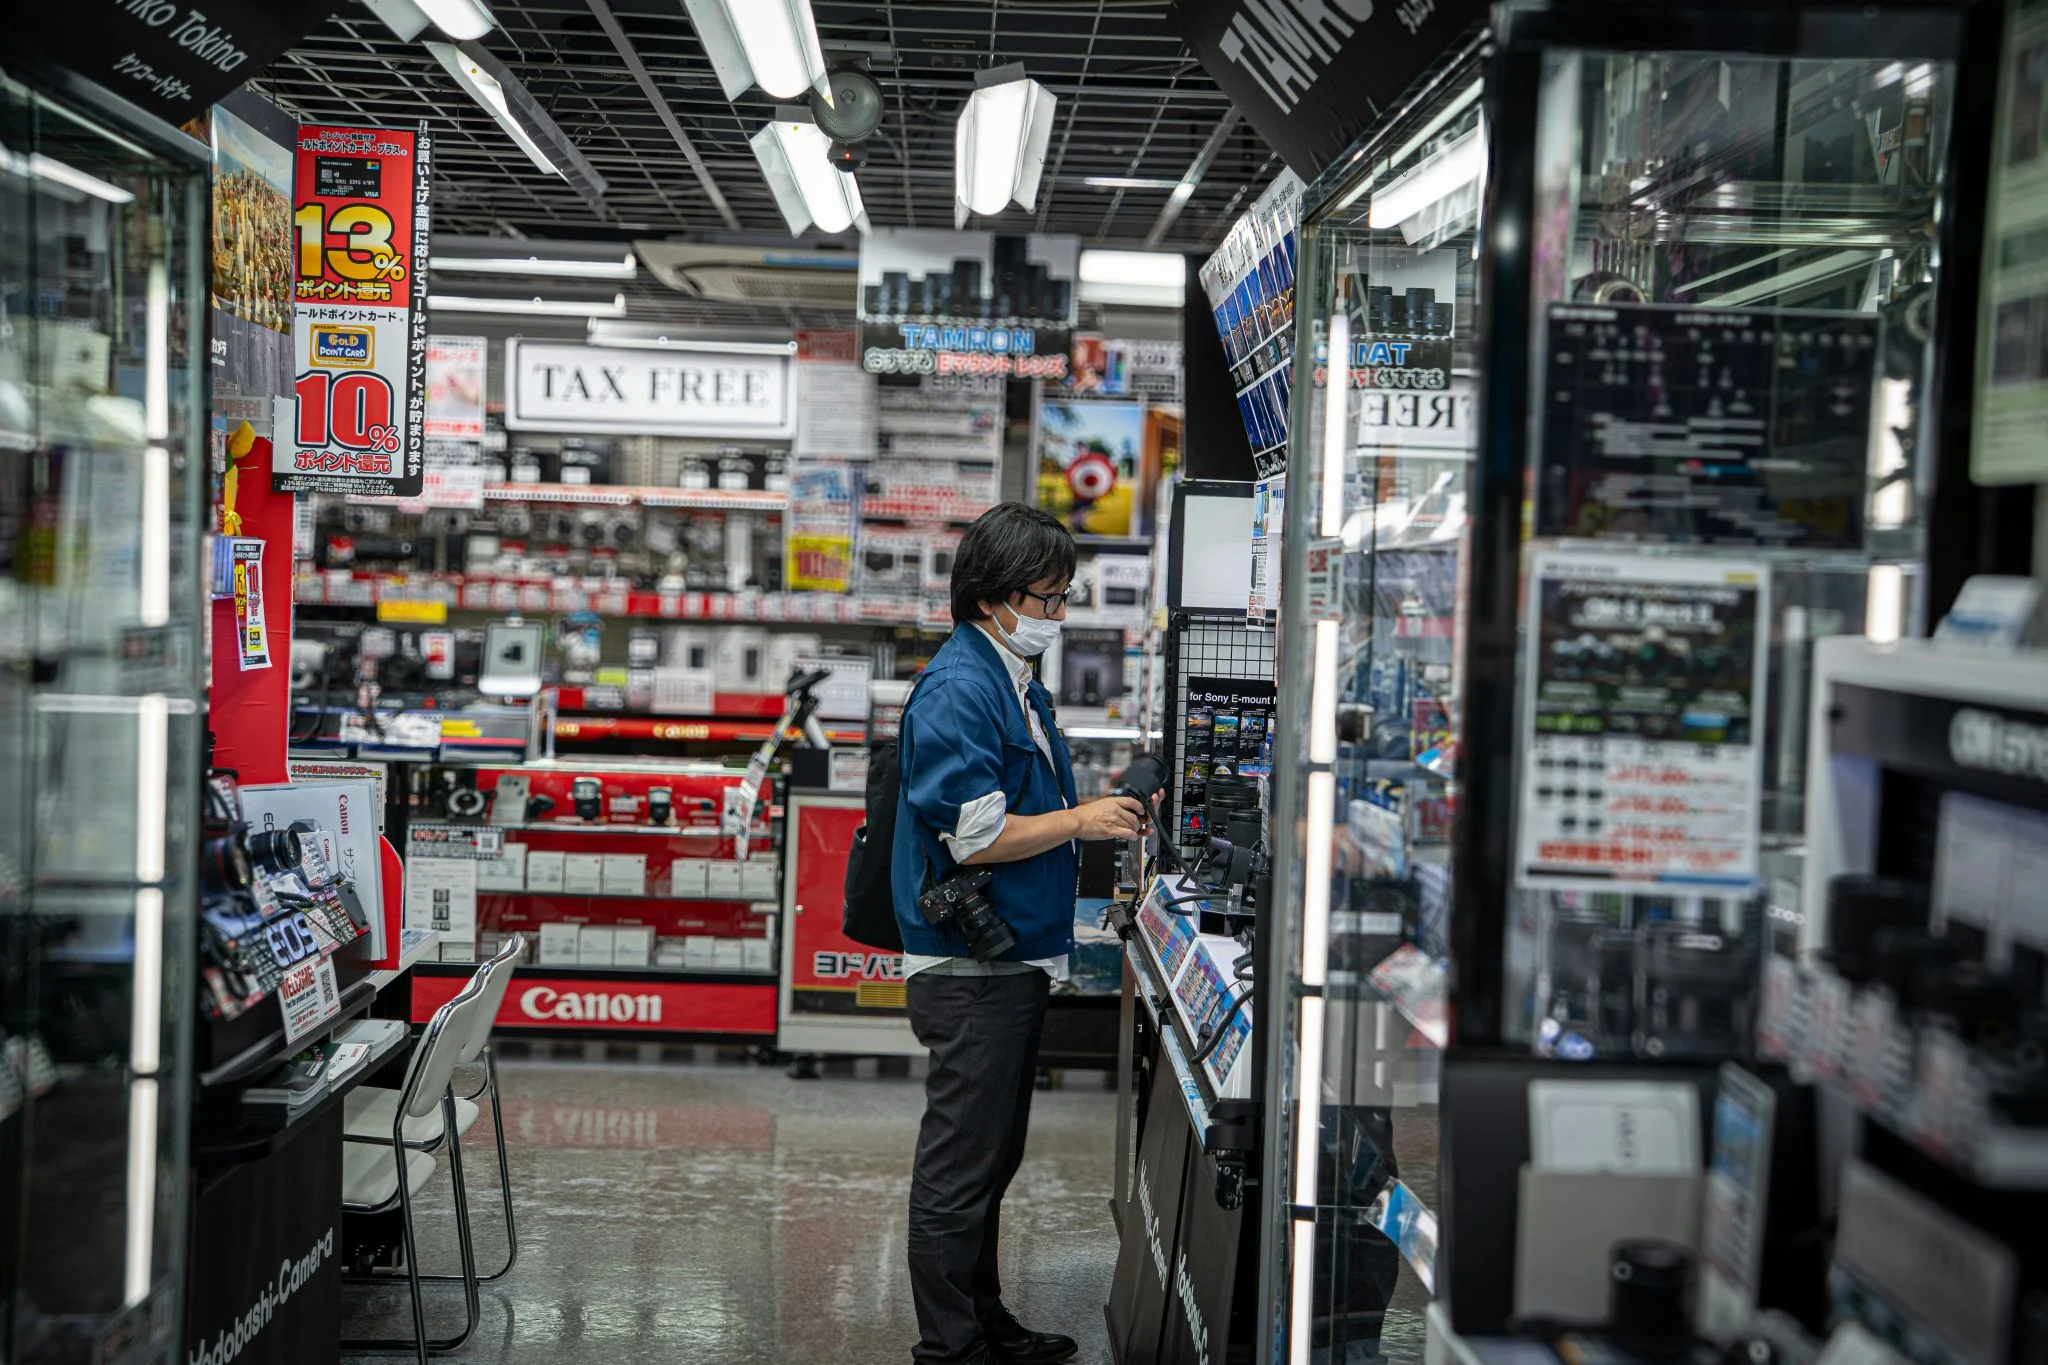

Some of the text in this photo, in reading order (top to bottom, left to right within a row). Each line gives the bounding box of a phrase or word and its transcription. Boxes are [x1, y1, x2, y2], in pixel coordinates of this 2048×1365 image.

[168, 9, 248, 72] Tokina
[295, 203, 405, 281] 13%
[296, 279, 391, 300] ポイント還元
[319, 346, 366, 357] POINT CARD
[899, 324, 1035, 355] TAMRON
[532, 363, 627, 402] TAX
[648, 367, 771, 406] FREE
[295, 370, 400, 453] 10%
[294, 450, 392, 473] ポイント還元
[1189, 692, 1270, 704] for Sony E-mount
[339, 794, 349, 834] Canon
[266, 911, 318, 967] EOS
[520, 986, 662, 1023] Canon
